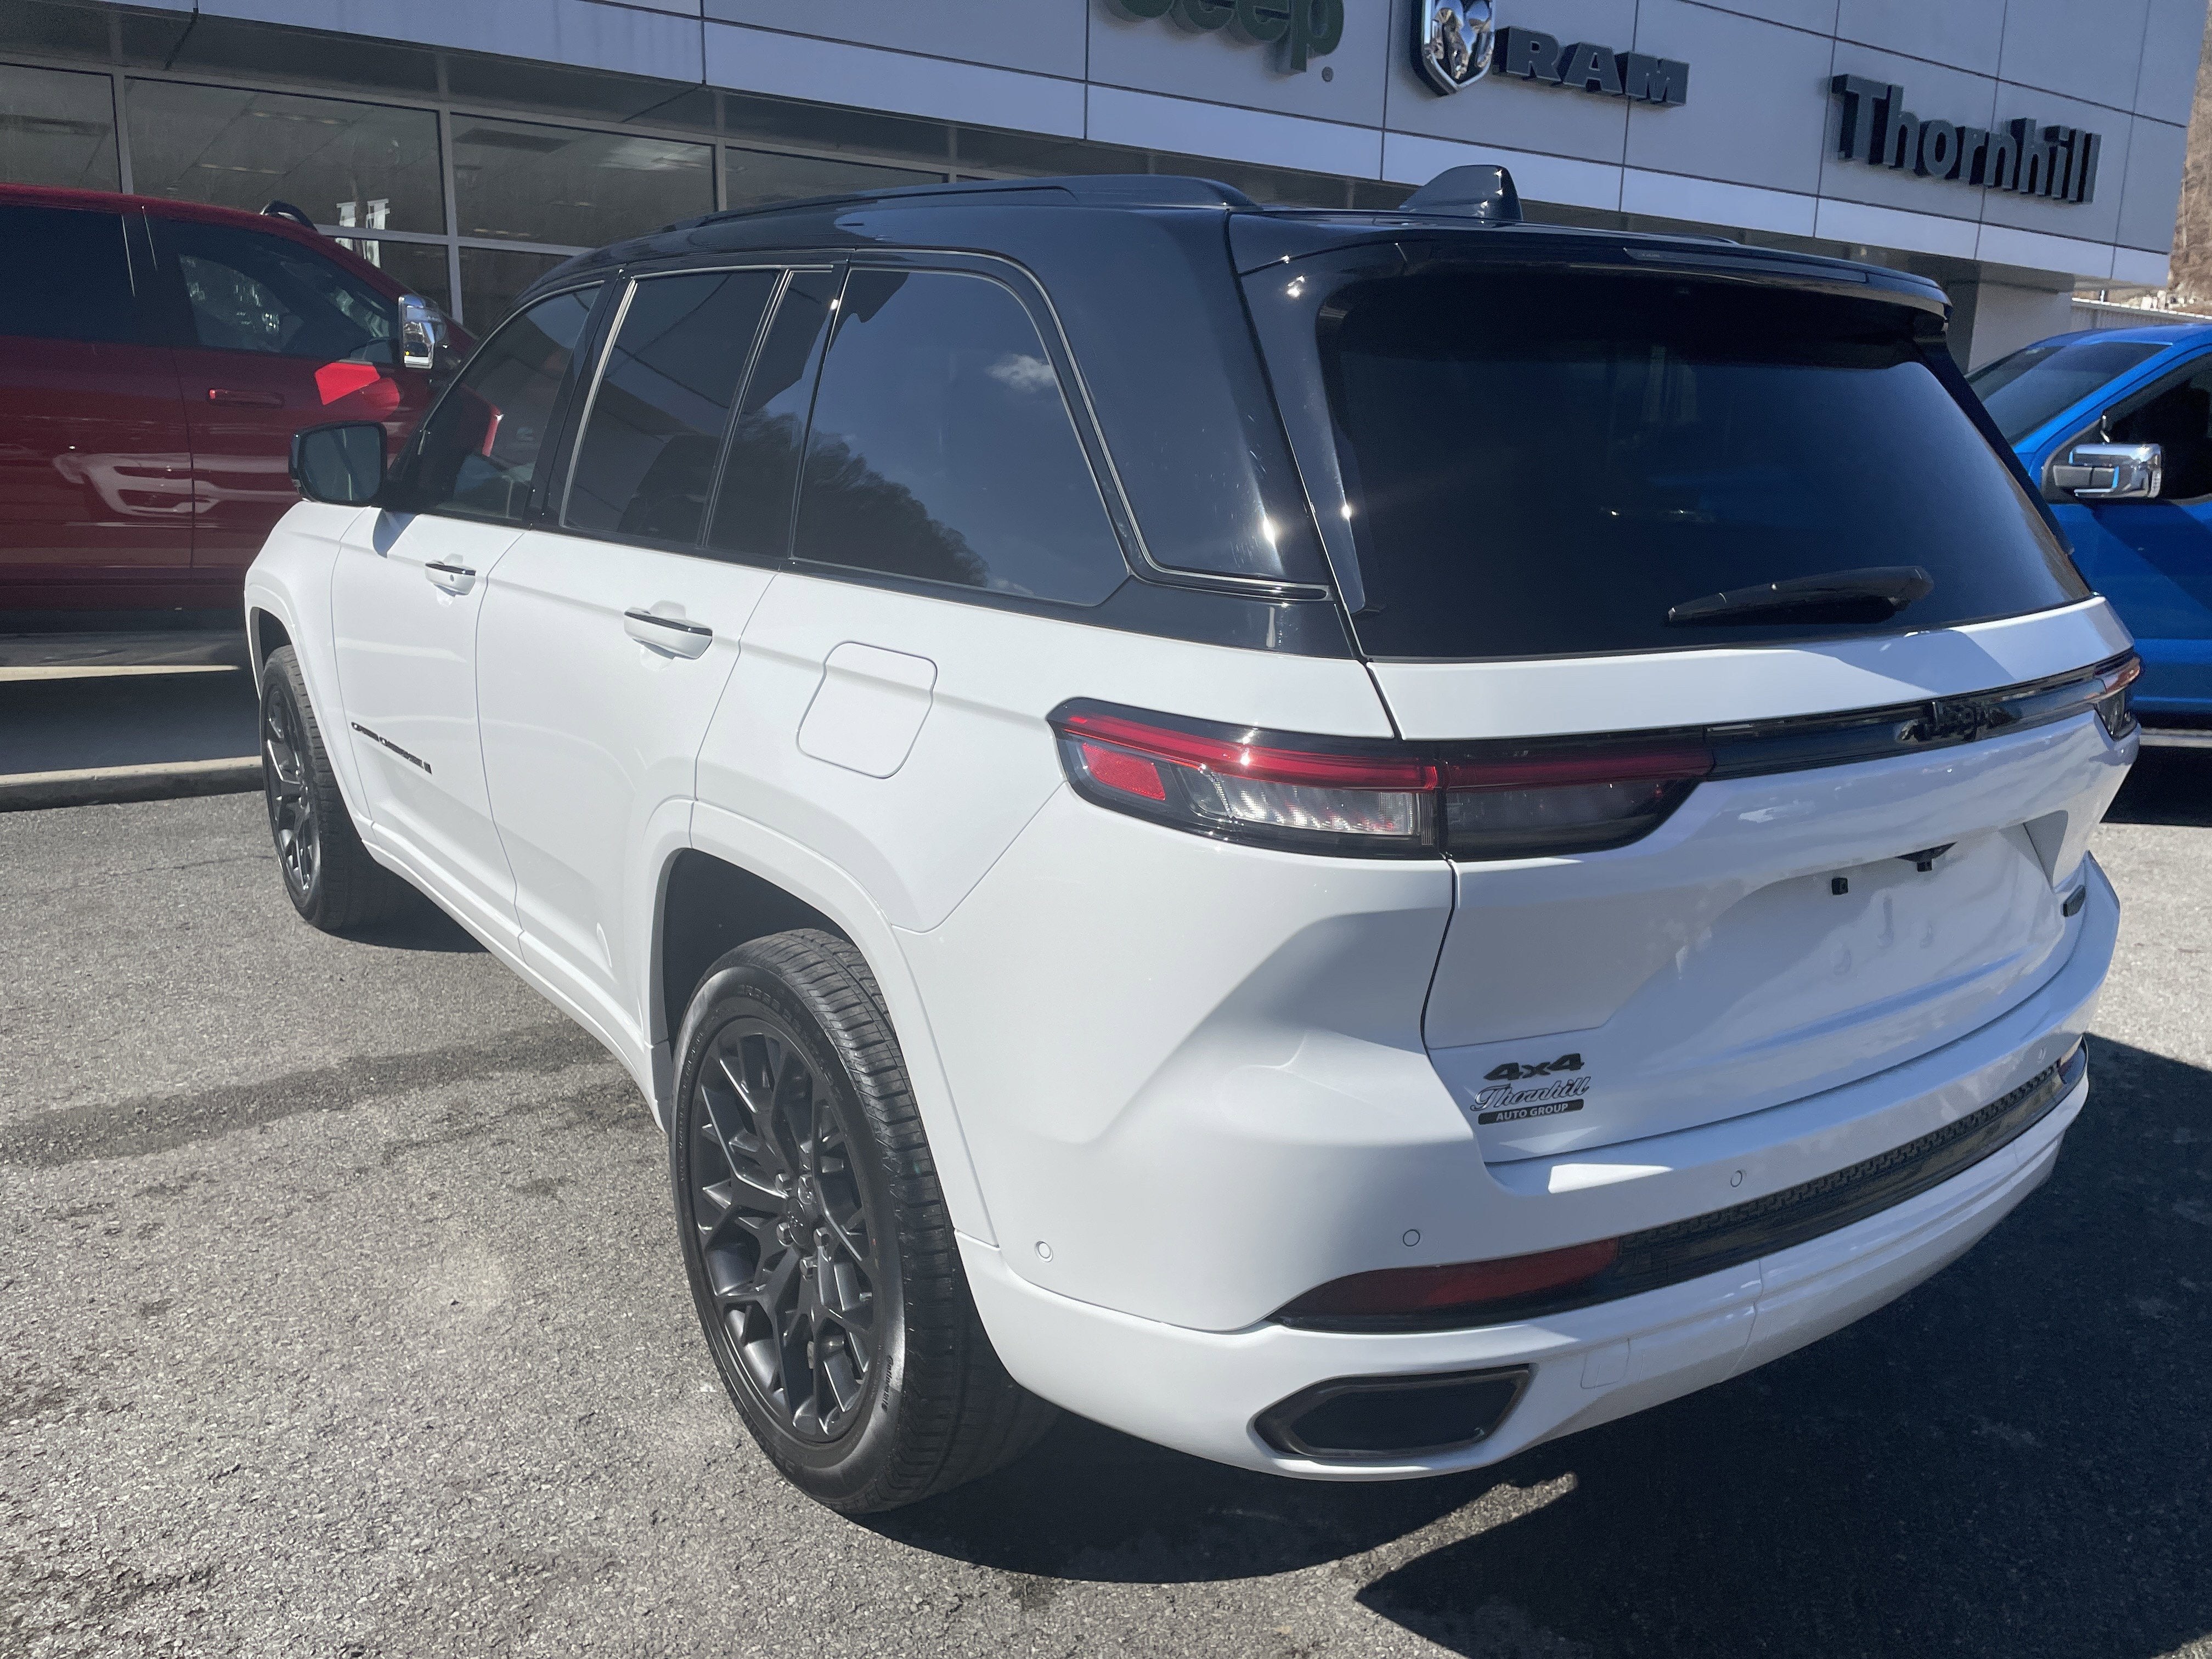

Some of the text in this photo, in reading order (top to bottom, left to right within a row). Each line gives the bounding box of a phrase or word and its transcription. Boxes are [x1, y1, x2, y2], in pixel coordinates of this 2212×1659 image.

[1109, 0, 1344, 72] eep
[1494, 26, 1689, 105] RAM
[1832, 74, 2101, 203] Thornhill
[1483, 1052, 1585, 1081] 4x4
[1470, 1076, 1592, 1111] Thornhill
[1496, 1103, 1568, 1121] AUTO GROUP
